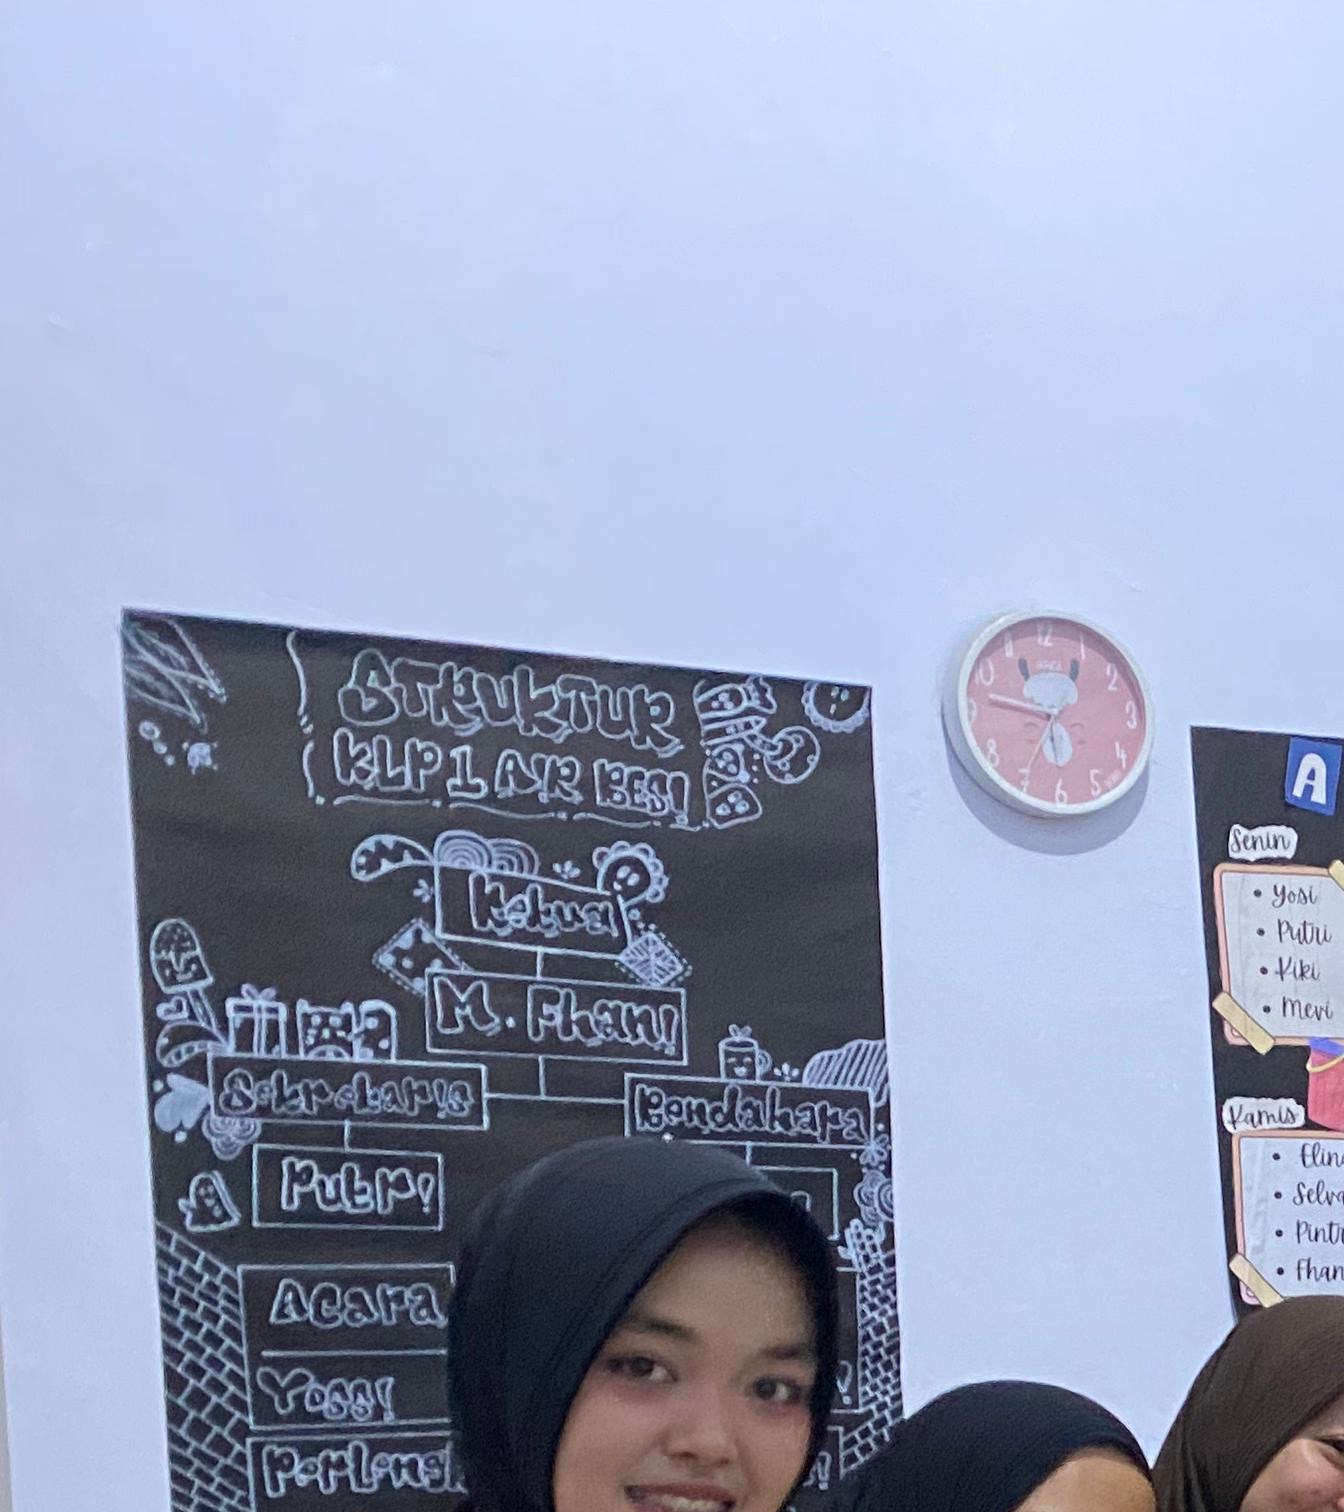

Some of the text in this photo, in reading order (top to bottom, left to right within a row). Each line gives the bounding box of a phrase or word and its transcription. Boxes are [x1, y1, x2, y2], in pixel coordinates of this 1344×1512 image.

[974, 658, 995, 686] 10
[1106, 662, 1118, 691] 2
[338, 649, 684, 758] STRUKTUR
[1126, 701, 1137, 729] 3
[333, 727, 443, 793] KLP
[446, 745, 488, 799] 1
[986, 738, 999, 768] 8
[1115, 741, 1127, 769] 4
[1055, 778, 1068, 804] 6
[1089, 768, 1102, 796] 5
[1230, 828, 1291, 853] Senin
[468, 871, 619, 938] Ketua
[1272, 884, 1317, 908] Yosi
[1277, 919, 1332, 945] Putri
[1275, 957, 1320, 981] Kiki
[1282, 996, 1334, 1020] Mevi
[219, 1068, 474, 1119] Sekretaris
[634, 1083, 870, 1144] Bendahara
[1229, 1104, 1299, 1129] Kamis
[281, 1157, 435, 1214] Putri
[269, 1278, 448, 1329] Acara
